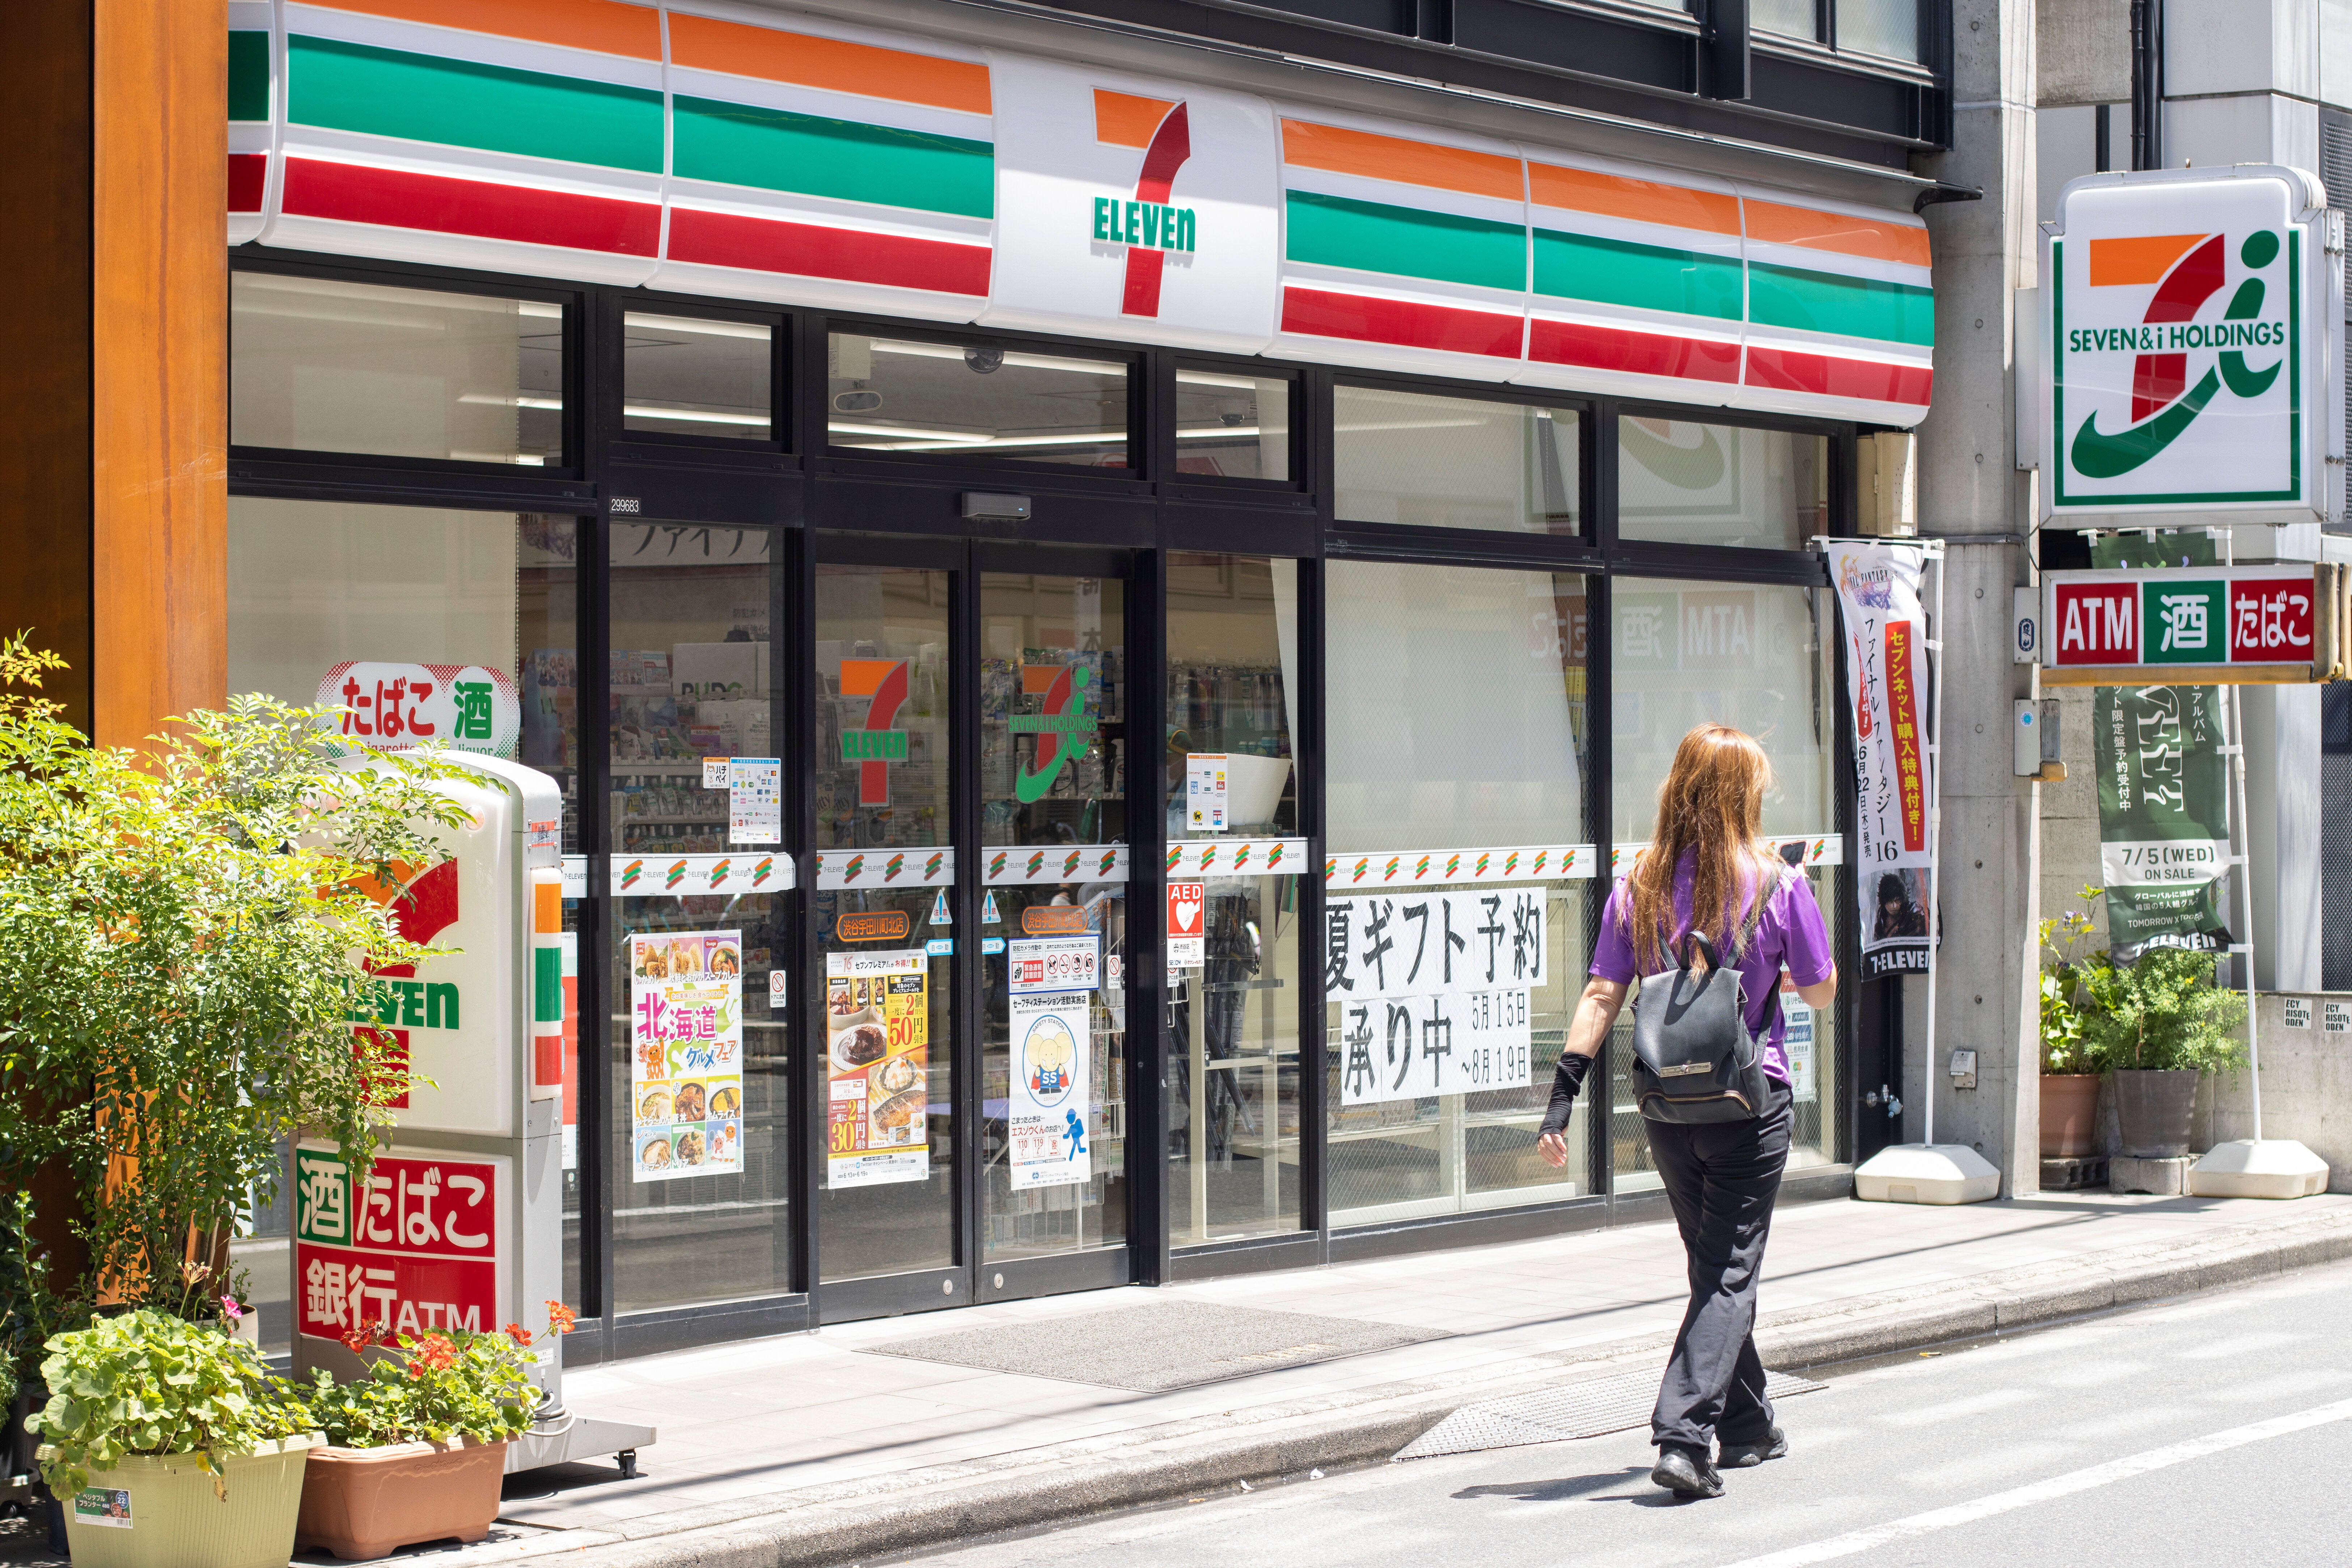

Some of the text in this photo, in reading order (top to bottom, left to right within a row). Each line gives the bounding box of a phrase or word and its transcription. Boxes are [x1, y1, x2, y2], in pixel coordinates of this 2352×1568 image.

[1093, 196, 1196, 252] ELEVEN
[2171, 322, 2284, 348] HOLDINGS
[611, 499, 639, 512] 299683
[1861, 570, 1888, 583] FANTASY
[2062, 597, 2132, 651] ATM
[2160, 594, 2209, 652] 酒
[2235, 589, 2311, 648] たばこ
[1865, 617, 1879, 713] ファイナル
[342, 676, 435, 738] たばこ
[454, 681, 493, 740] 酒
[1050, 716, 1098, 732] HOLDINGS
[843, 732, 905, 758] ELEVEN
[716, 766, 726, 774] ハチ
[716, 775, 726, 783] ペイ
[2145, 868, 2195, 880] ON SALE
[1170, 886, 1201, 900] AED
[843, 917, 904, 936] 渋谷宇田川町北店
[1027, 912, 1083, 929] 渋谷宇田川町北店
[2128, 917, 2173, 928] TOMORROW
[1326, 892, 1540, 993] 夏ギフト予約
[2132, 932, 2216, 958] 7-ELEVEN
[635, 975, 660, 984] いかめし
[705, 971, 739, 980] スープカレー
[1024, 971, 1042, 979] 装置設置
[1013, 995, 1086, 1008] セーフティステーション活動実施店
[2286, 999, 2300, 1009] ECY
[889, 1007, 905, 1016] 一度に
[1472, 992, 1524, 1031] 5月15日
[2286, 1009, 2310, 1020] RISOTE
[2326, 1004, 2340, 1013] ECY
[637, 993, 717, 1042] 北海道
[2285, 1018, 2304, 1027] ODEN
[2326, 1014, 2350, 1024] RISOTE
[889, 1017, 913, 1046] 50
[1033, 1018, 1065, 1033] SAFETY STATION
[2326, 1022, 2344, 1031] ODEN
[1344, 998, 1452, 1097] 承り中
[1793, 1044, 1809, 1053] 信用金庫
[1042, 1072, 1057, 1084] SS
[706, 1109, 736, 1121] オムライス
[831, 1113, 847, 1123] 一度に
[832, 1122, 855, 1152] 30
[1012, 1125, 1063, 1137] エスゾウくんのお店へ!
[1018, 1140, 1028, 1149] 110
[1033, 1139, 1044, 1148] 119
[300, 1159, 346, 1235] 酒
[356, 1166, 488, 1247] たばこ
[83, 1493, 105, 1502] ベジタブル
